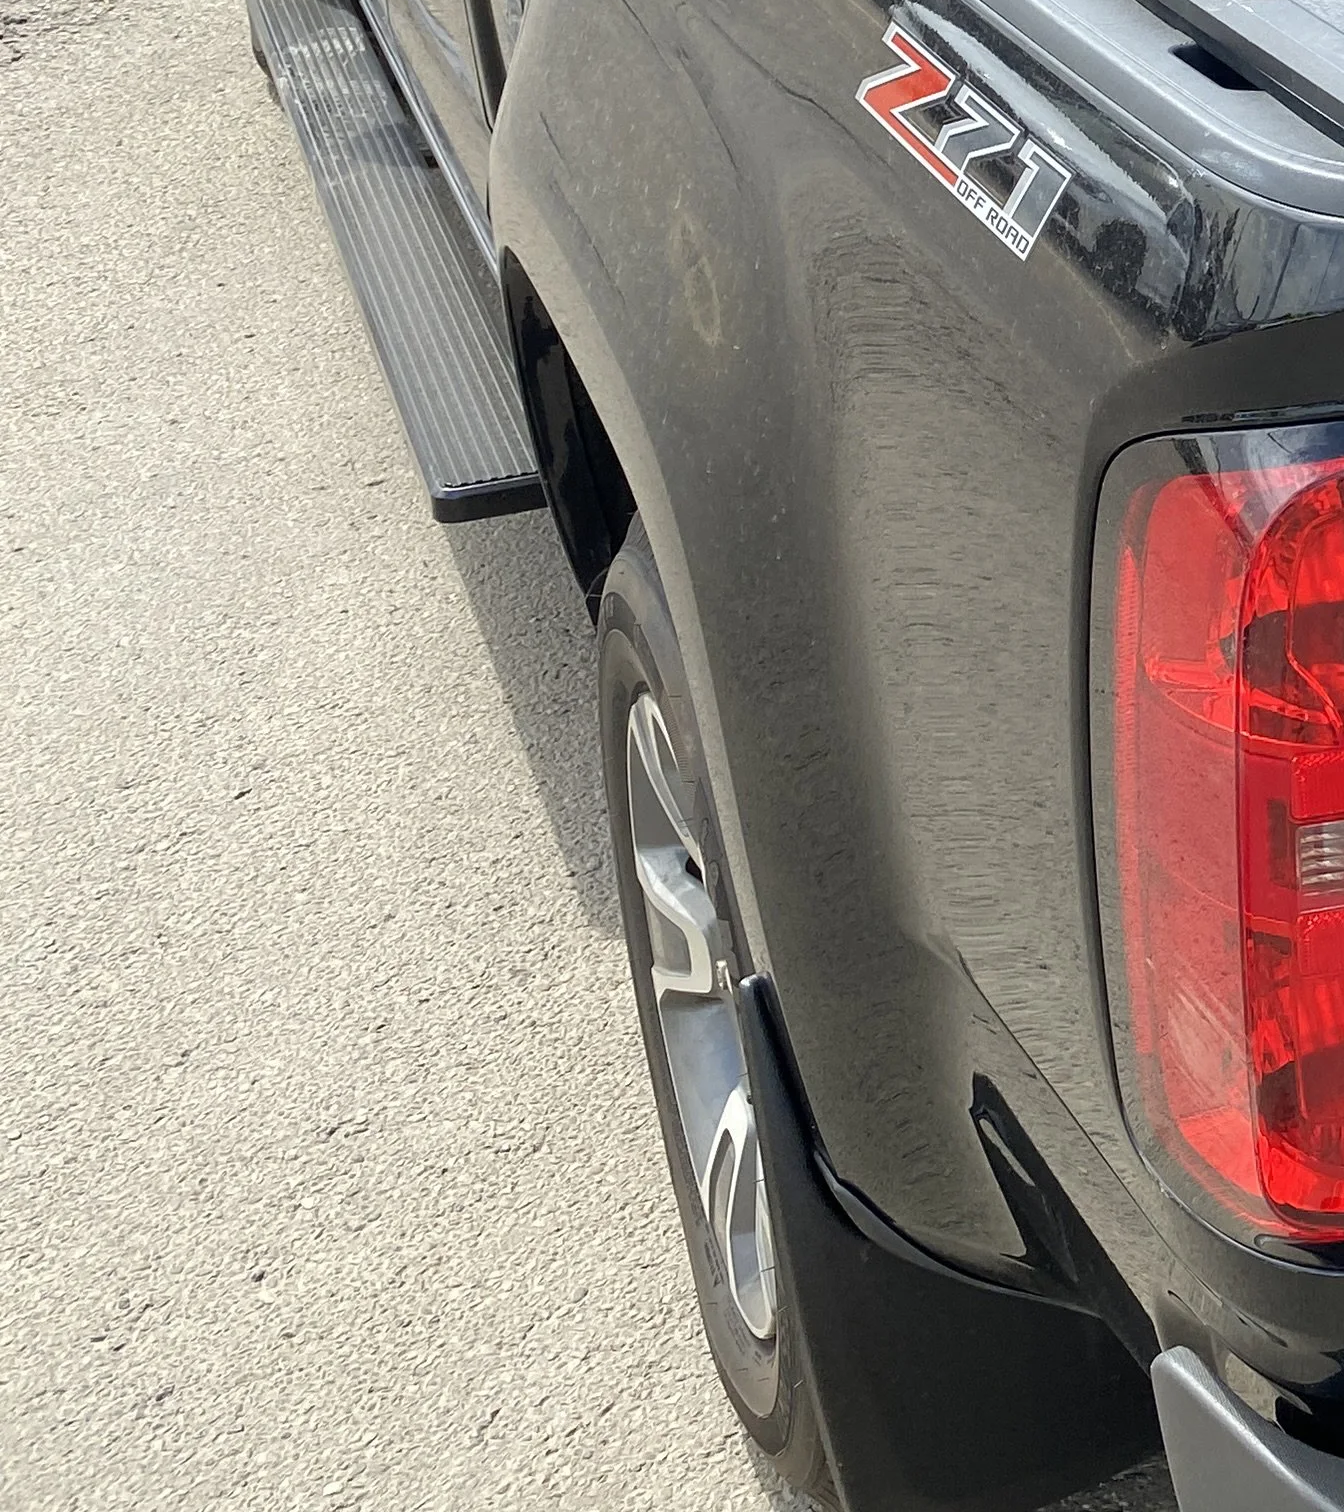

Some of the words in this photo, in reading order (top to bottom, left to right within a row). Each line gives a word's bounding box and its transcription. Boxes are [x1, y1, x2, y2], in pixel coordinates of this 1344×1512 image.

[855, 20, 1075, 239] Z71
[956, 178, 987, 209] OFF
[985, 206, 1030, 255] ROAD
